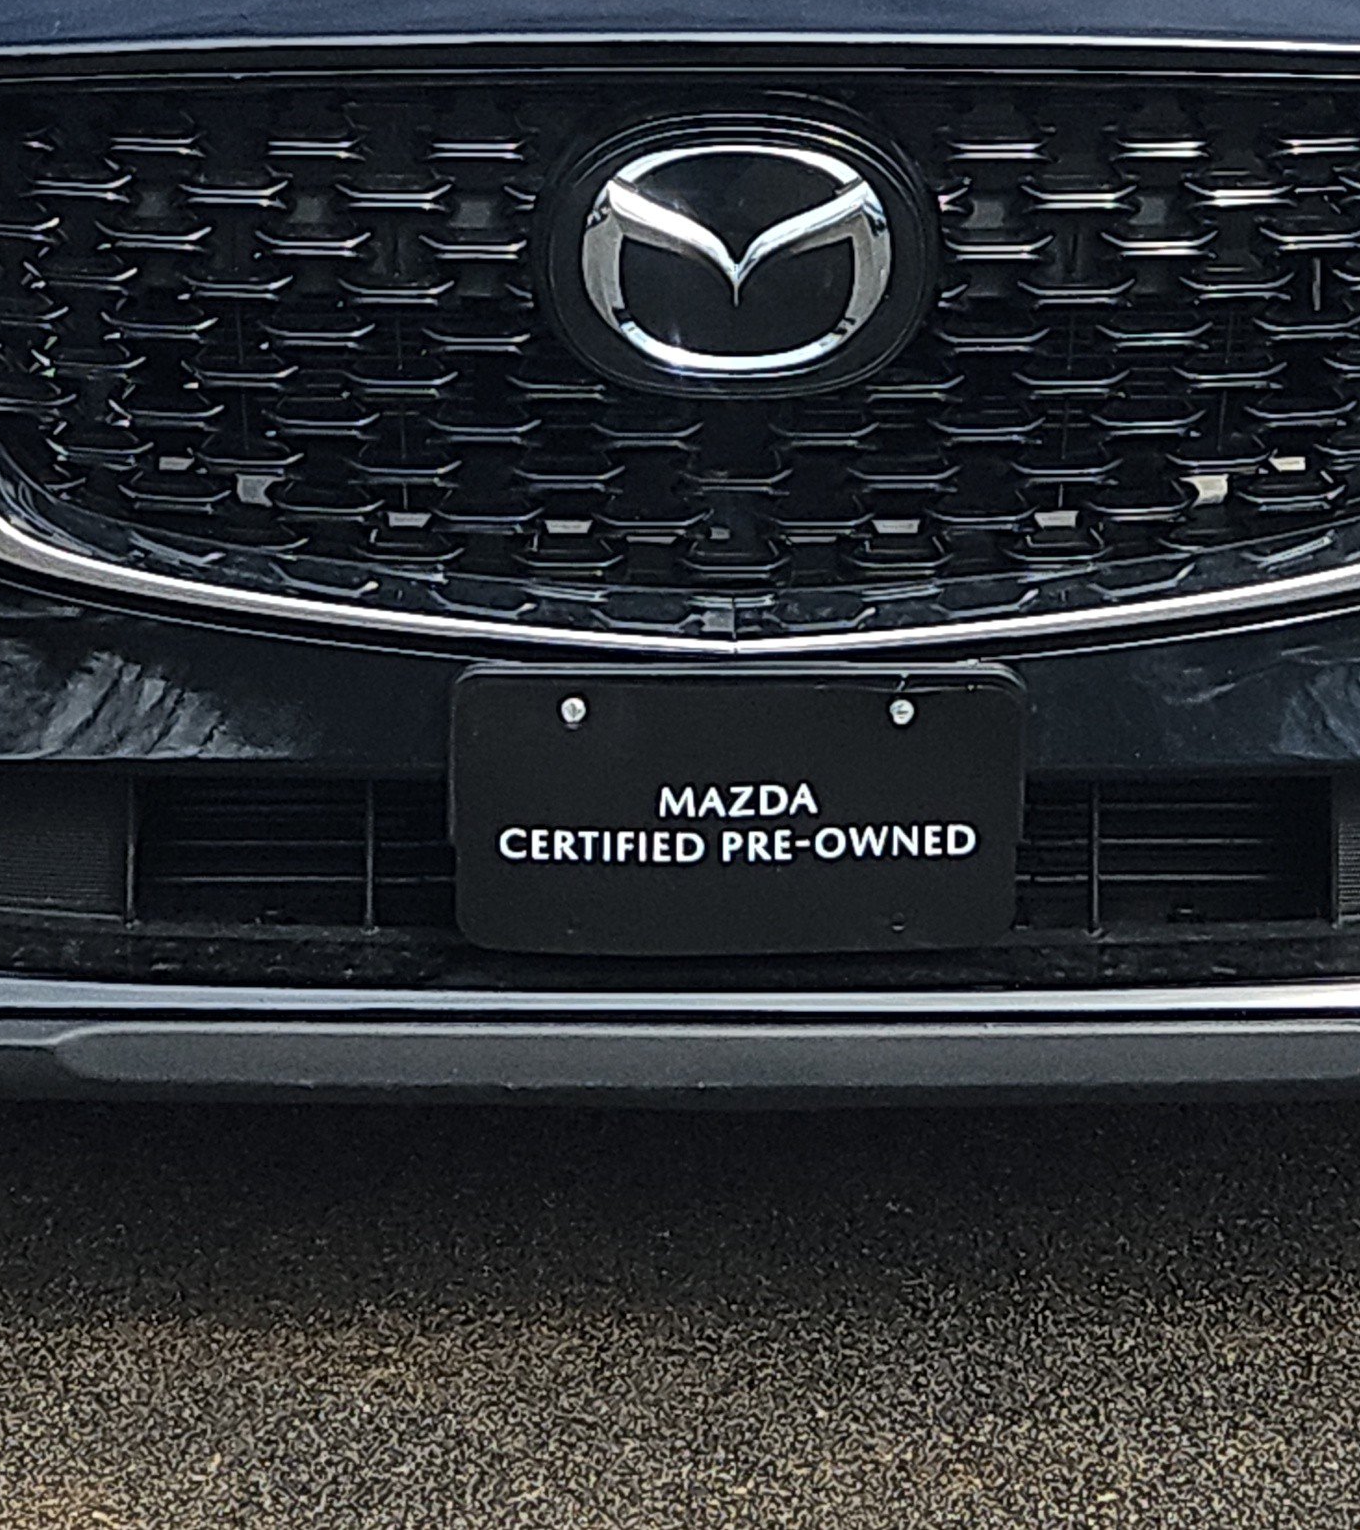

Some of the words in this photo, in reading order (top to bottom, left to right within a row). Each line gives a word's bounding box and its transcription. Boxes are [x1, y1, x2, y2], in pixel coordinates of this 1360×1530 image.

[658, 782, 819, 819] MAZDA
[498, 826, 706, 863] CERTIFIED
[721, 823, 977, 862] PRE-OWNED
